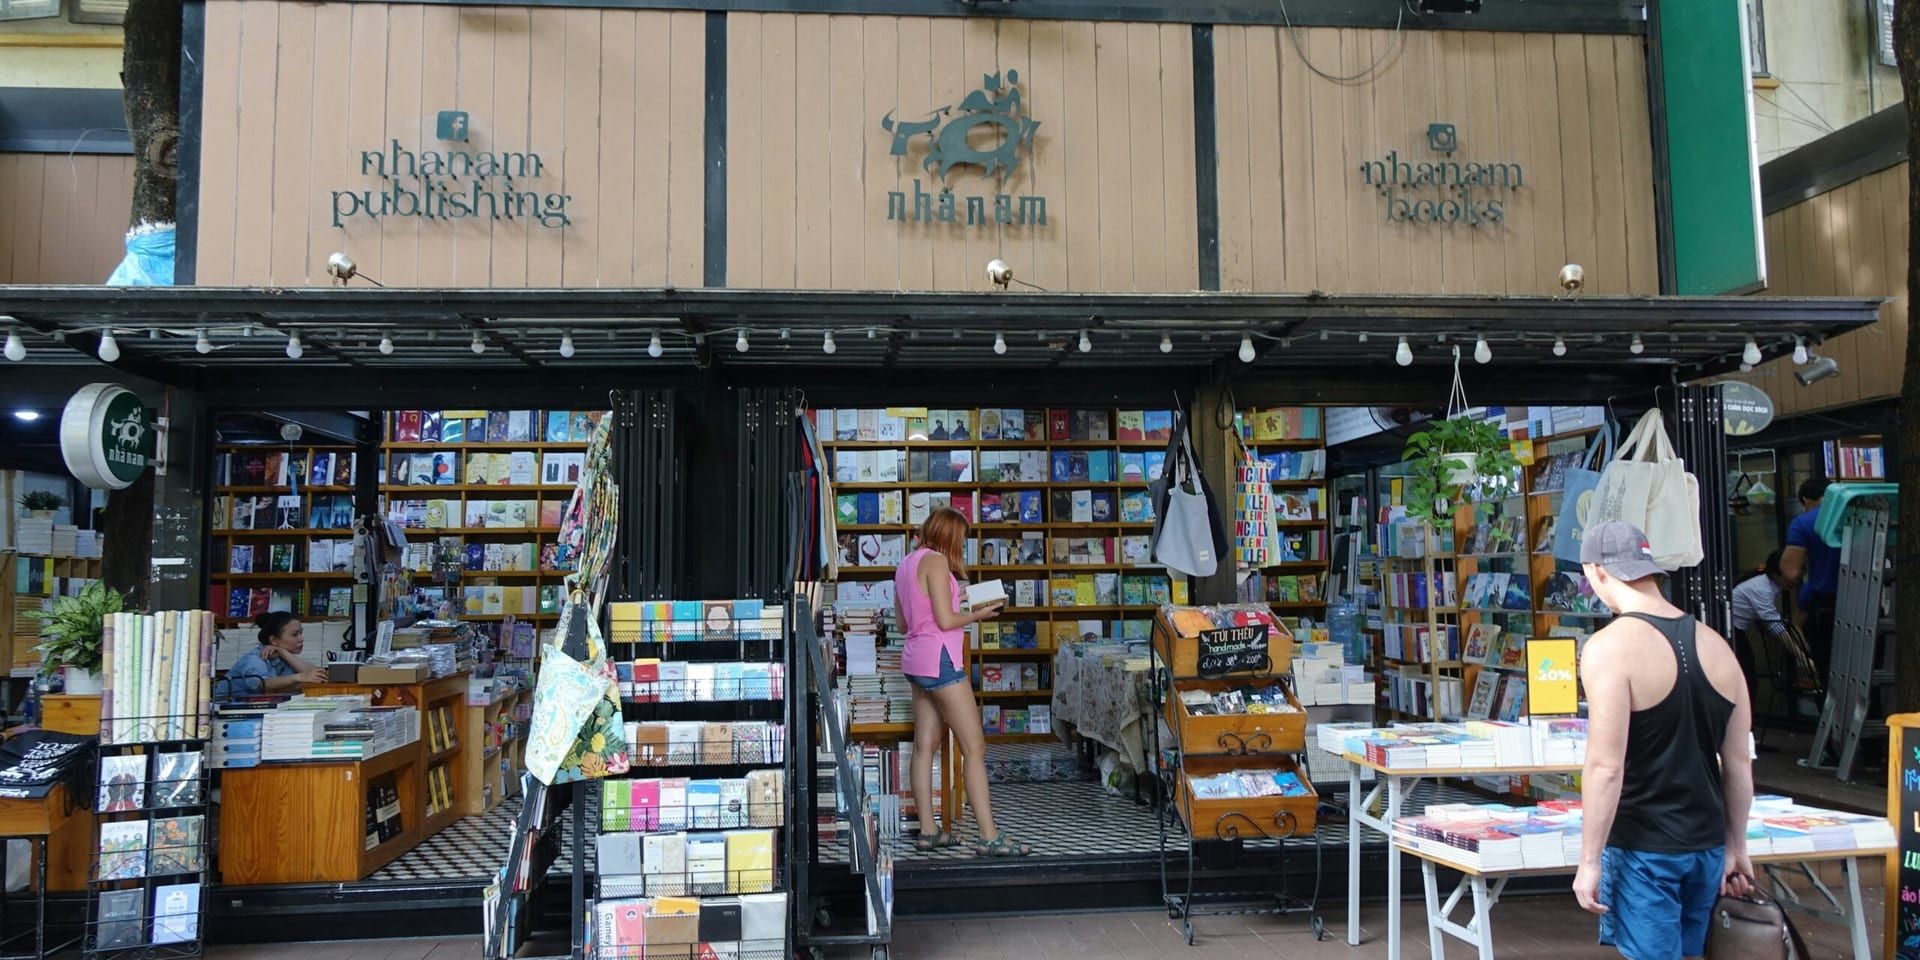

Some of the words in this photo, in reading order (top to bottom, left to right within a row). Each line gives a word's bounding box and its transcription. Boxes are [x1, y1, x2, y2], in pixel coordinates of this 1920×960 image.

[361, 139, 542, 178] nhanam
[1364, 151, 1522, 187] nhanam
[330, 179, 572, 228] publishing
[1387, 187, 1504, 224] books
